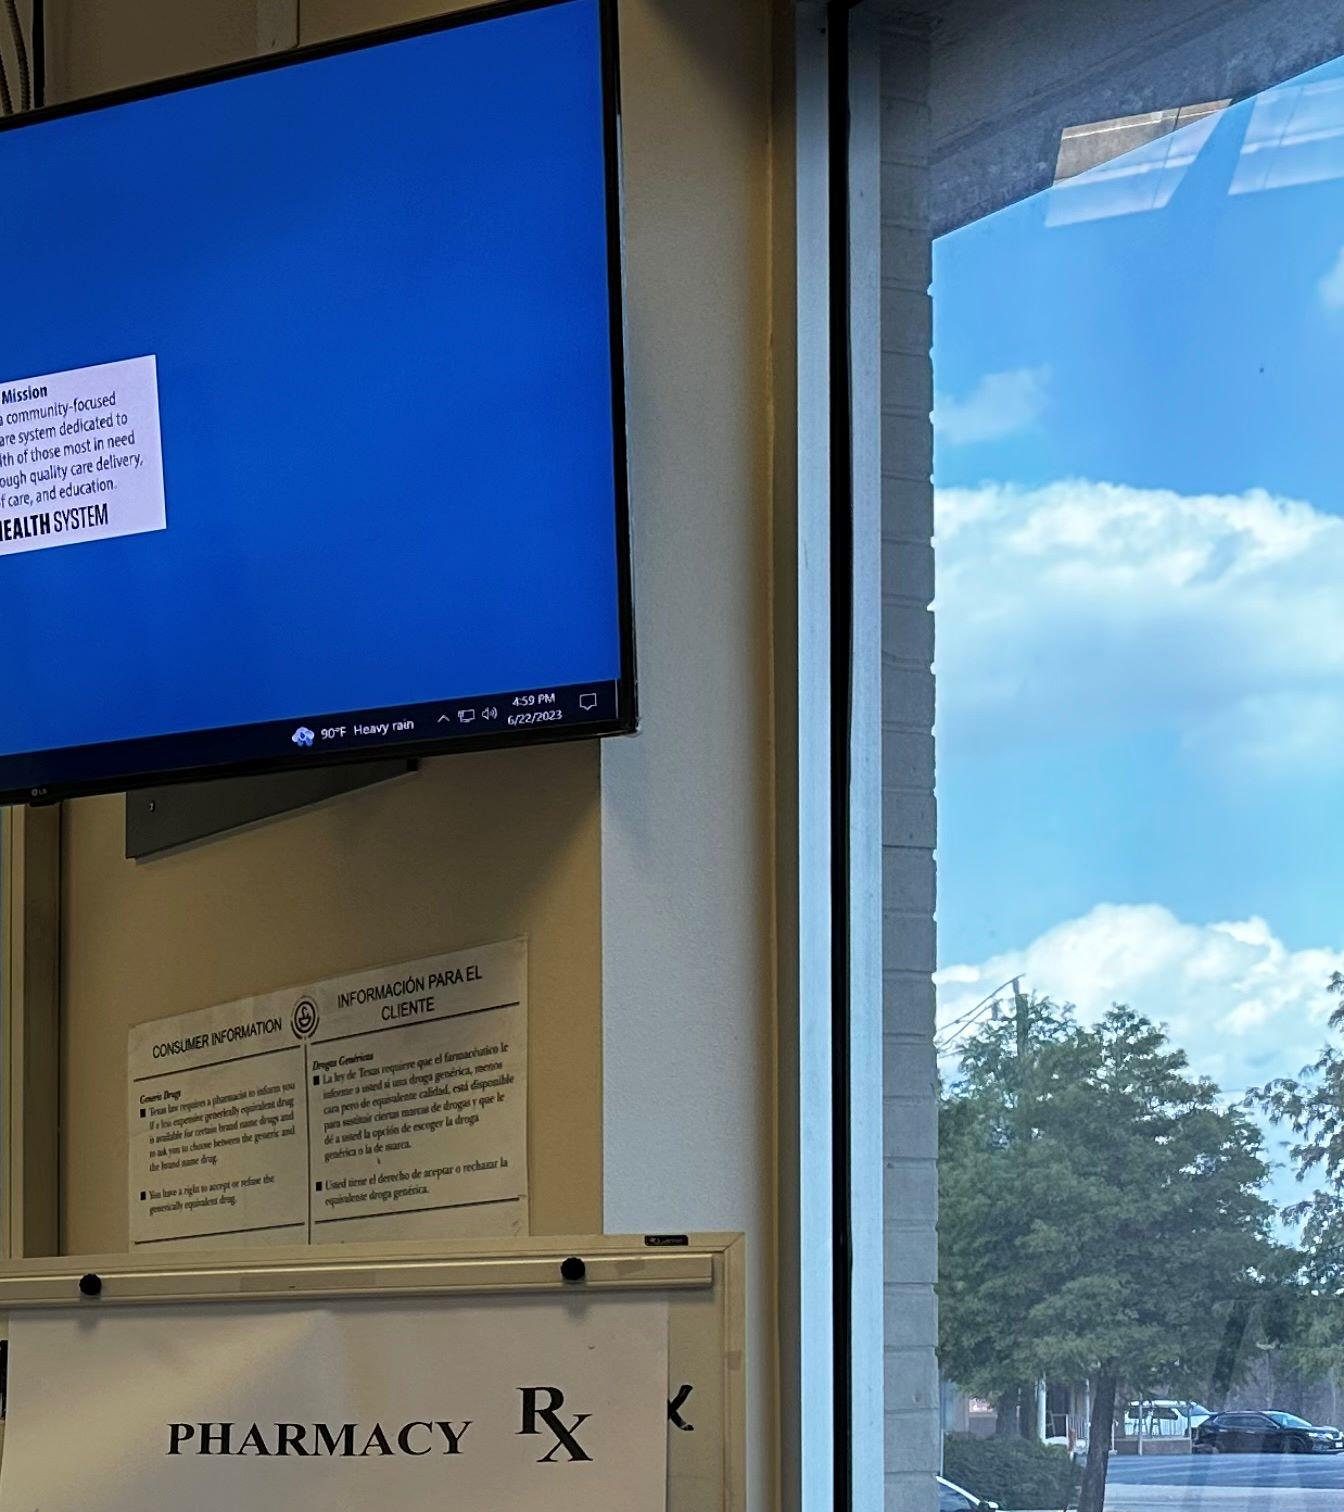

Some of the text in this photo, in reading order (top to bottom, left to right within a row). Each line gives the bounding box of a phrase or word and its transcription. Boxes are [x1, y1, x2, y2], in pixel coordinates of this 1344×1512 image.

[1, 385, 48, 405] Mission
[6, 391, 116, 425] community-focused
[18, 426, 56, 446] system
[59, 413, 114, 436] dedicated
[115, 413, 128, 427] to
[16, 448, 29, 465] of
[30, 446, 61, 463] those
[63, 439, 92, 456] most
[93, 437, 104, 452] in
[107, 430, 136, 448] need
[29, 464, 68, 486] quality
[70, 462, 93, 476] care
[96, 453, 143, 472] delivery,
[7, 494, 34, 507] care,
[35, 485, 57, 504] and
[53, 503, 108, 533] SYSTEM
[538, 693, 556, 705] PM
[353, 722, 389, 737] Heavy
[392, 719, 415, 731] rain
[507, 709, 563, 725] 6/22/2023
[337, 964, 483, 1009] INFORMACIÓN PARA EL
[380, 996, 435, 1021] CLIENTE
[152, 1017, 283, 1060] CONSUMER INFORMATION
[169, 1421, 469, 1457] PHARMACY
